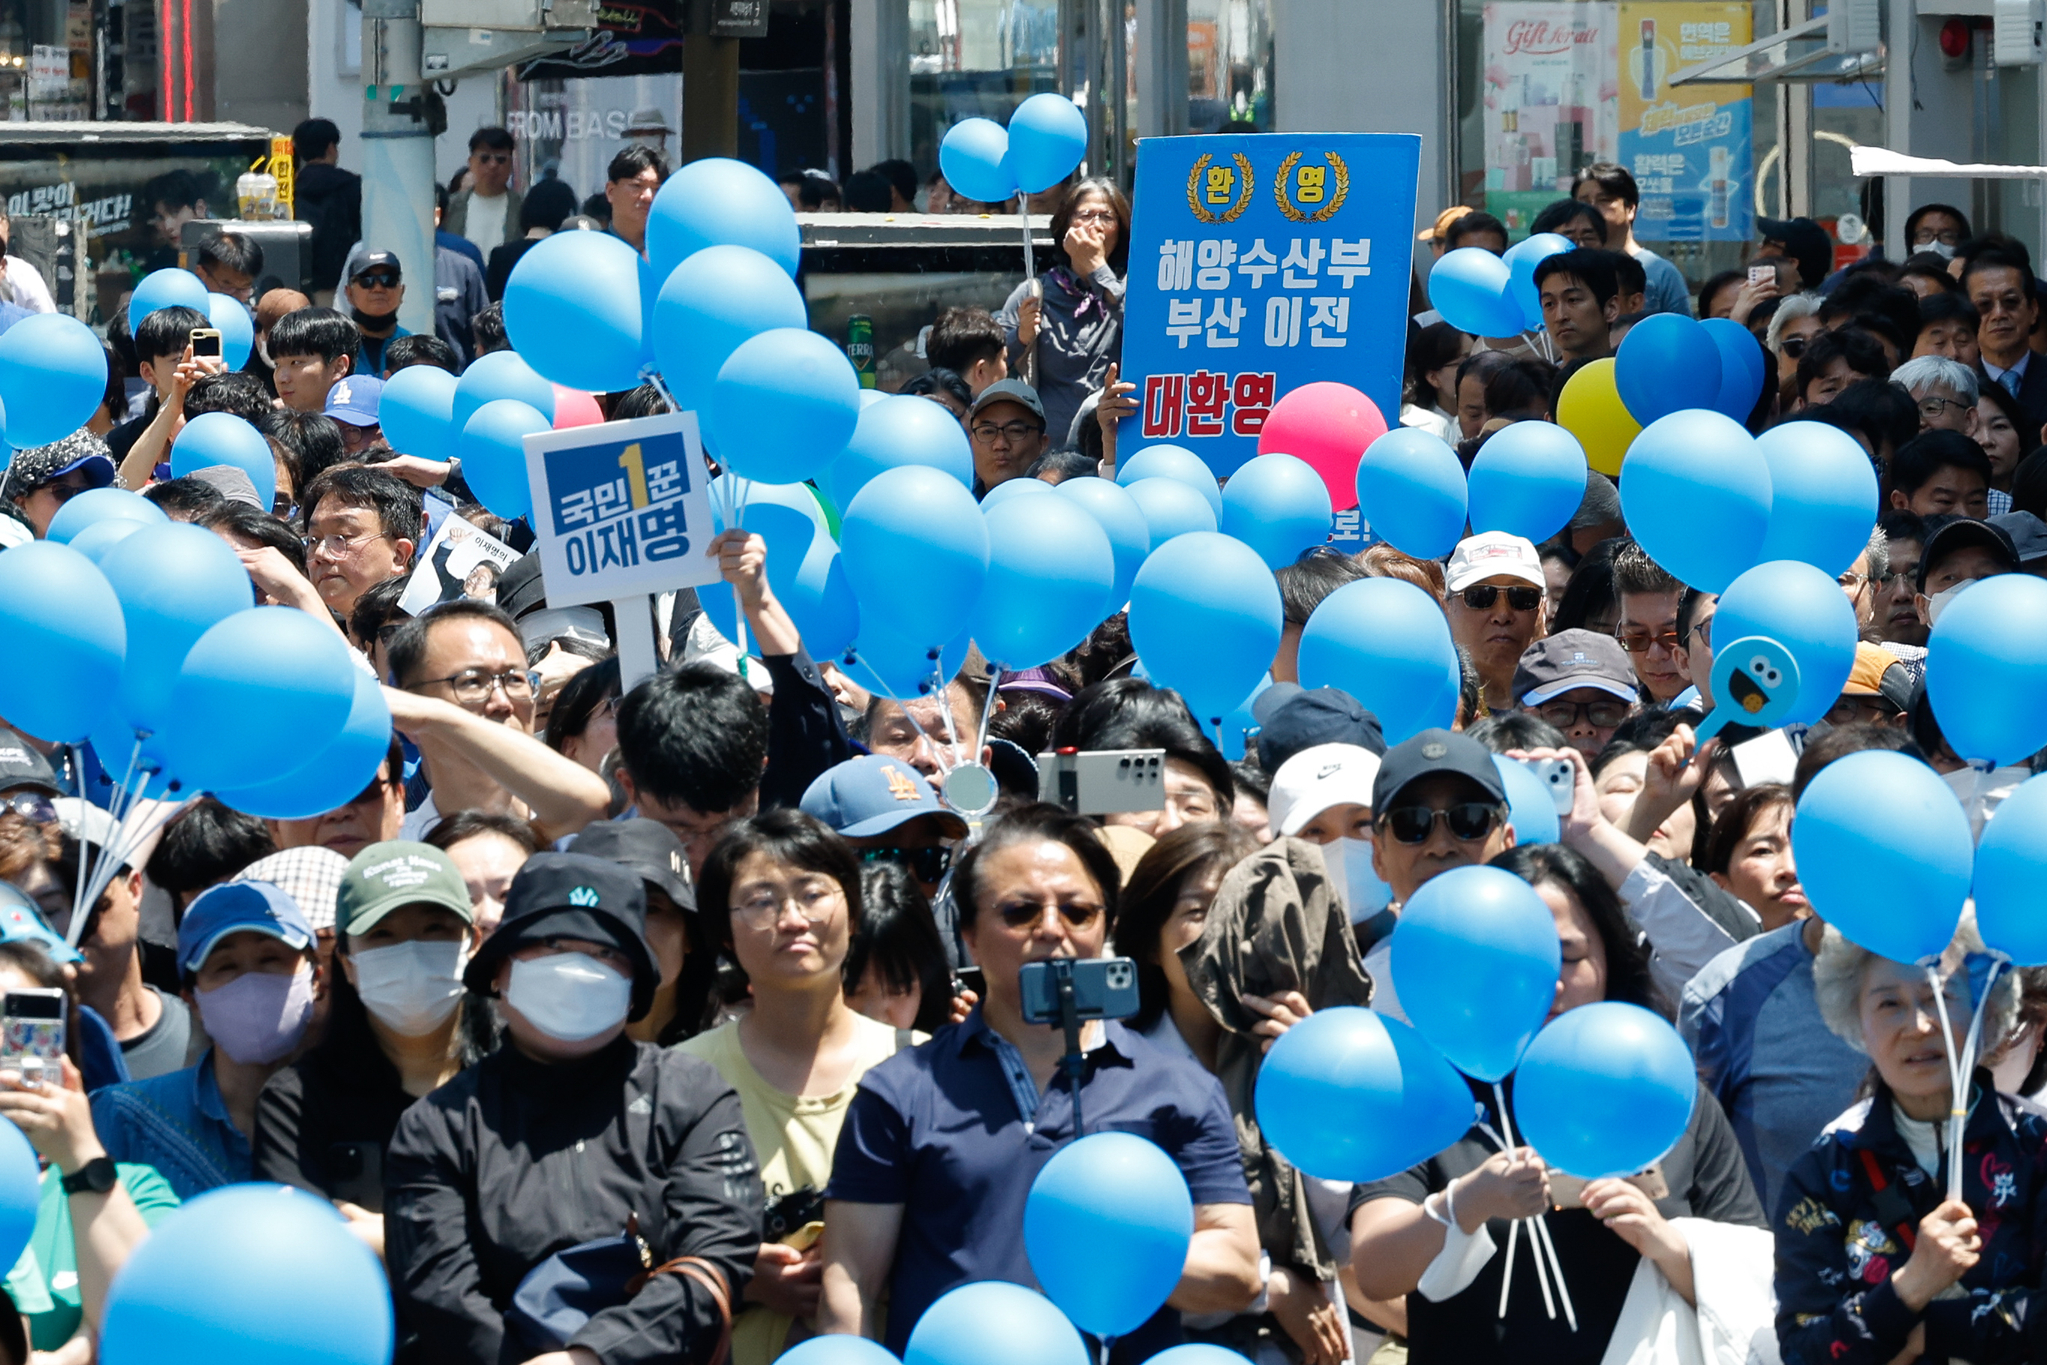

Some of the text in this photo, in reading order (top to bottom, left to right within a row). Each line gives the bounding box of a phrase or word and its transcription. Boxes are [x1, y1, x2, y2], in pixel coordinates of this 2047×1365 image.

[1503, 20, 1549, 55] Gift
[506, 111, 563, 140] FROM
[1206, 166, 1325, 204] 환 영
[1157, 238, 1371, 291] 해양수산부
[1166, 296, 1350, 349] 부산 이전
[847, 343, 874, 358] TERRA
[1142, 370, 1276, 438] 대환영
[561, 443, 682, 525] 국민1꾼
[475, 536, 508, 562] 이재명의
[565, 500, 690, 576] 이재명
[879, 764, 922, 801] LA
